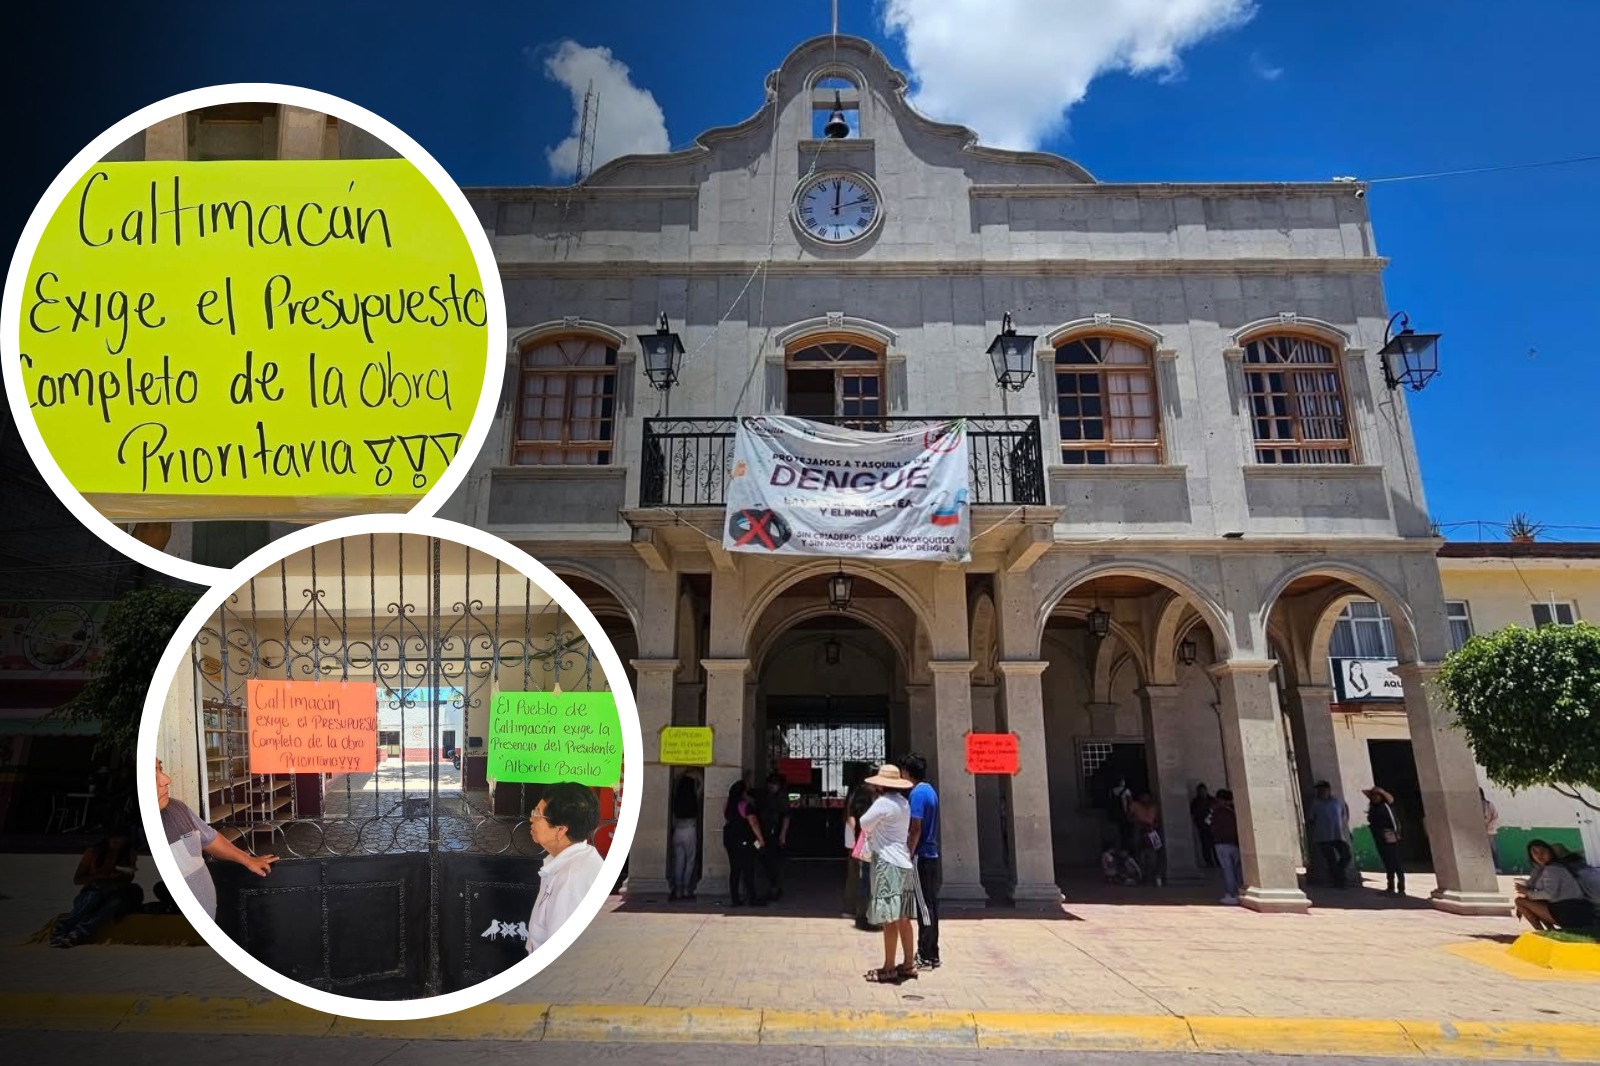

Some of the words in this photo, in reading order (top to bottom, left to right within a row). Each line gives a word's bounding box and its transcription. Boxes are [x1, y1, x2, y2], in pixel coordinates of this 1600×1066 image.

[78, 172, 393, 248] Caltimacán
[29, 272, 166, 355] Exige
[196, 276, 237, 336] el
[264, 274, 487, 344] Presupuesto
[229, 350, 285, 402] de
[309, 353, 348, 408] la
[360, 351, 453, 411] Obra
[772, 453, 841, 468] PROTEJAMOS
[769, 464, 929, 493] DENGUE
[819, 507, 827, 518] Y
[830, 508, 878, 518] ELIMINA
[796, 531, 812, 540] SIN
[867, 535, 880, 543] NO
[883, 535, 900, 543] HAY
[902, 536, 955, 545] MOSQUITOS
[809, 540, 824, 548] SIN
[825, 541, 878, 550] MOSQUITOS
[880, 543, 894, 551] NO
[915, 544, 951, 553] DENGUE
[254, 683, 341, 715] Caltimacán
[496, 696, 510, 714] El
[516, 698, 558, 716] Pueblo
[565, 700, 588, 716] de
[256, 715, 290, 735] exige
[297, 715, 307, 728] el
[494, 717, 556, 736] Caltimacán
[563, 724, 594, 739] exige
[599, 722, 611, 736] la
[252, 730, 303, 751] Completo
[308, 734, 323, 749] de
[327, 734, 337, 749] la
[490, 736, 537, 751] Presencia
[543, 739, 561, 752] del
[565, 740, 617, 755] Presidente
